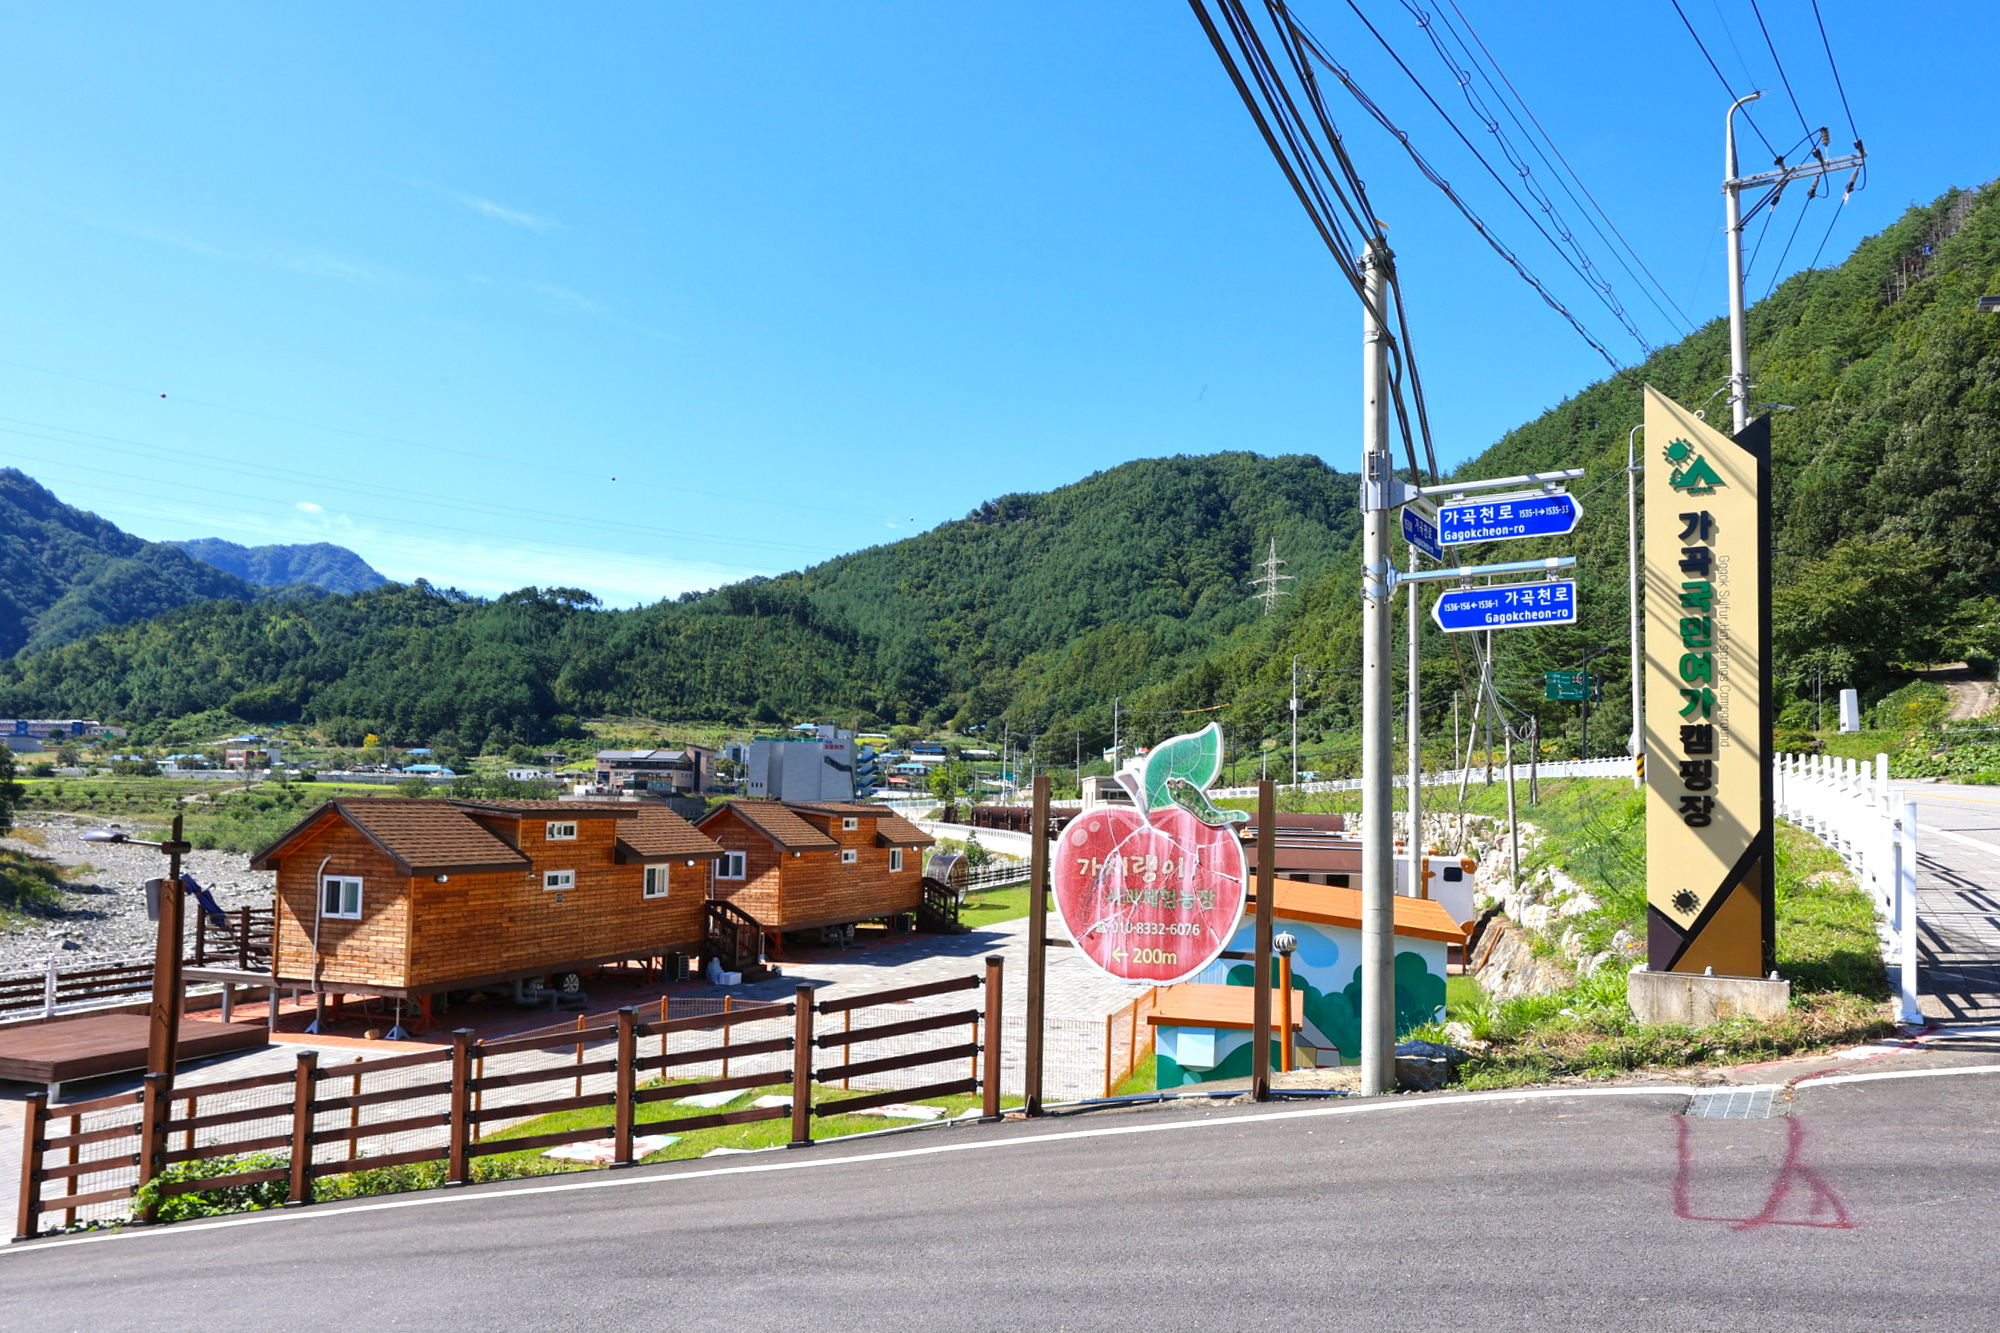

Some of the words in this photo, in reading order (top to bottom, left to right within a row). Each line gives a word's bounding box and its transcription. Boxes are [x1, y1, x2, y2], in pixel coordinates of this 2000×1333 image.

[1444, 505, 1514, 525] 가곡천로
[1444, 525, 1525, 541] Gagokcheon-ro
[1444, 601, 1471, 612] 1536-156
[1504, 587, 1569, 606] 가곡천로
[1485, 609, 1569, 624] Gagokcheon-ro
[1718, 645, 1731, 681] springs
[1718, 685, 1731, 747] Campground
[1111, 922, 1200, 935] 010-8332-6076
[1132, 948, 1178, 964] 200m
